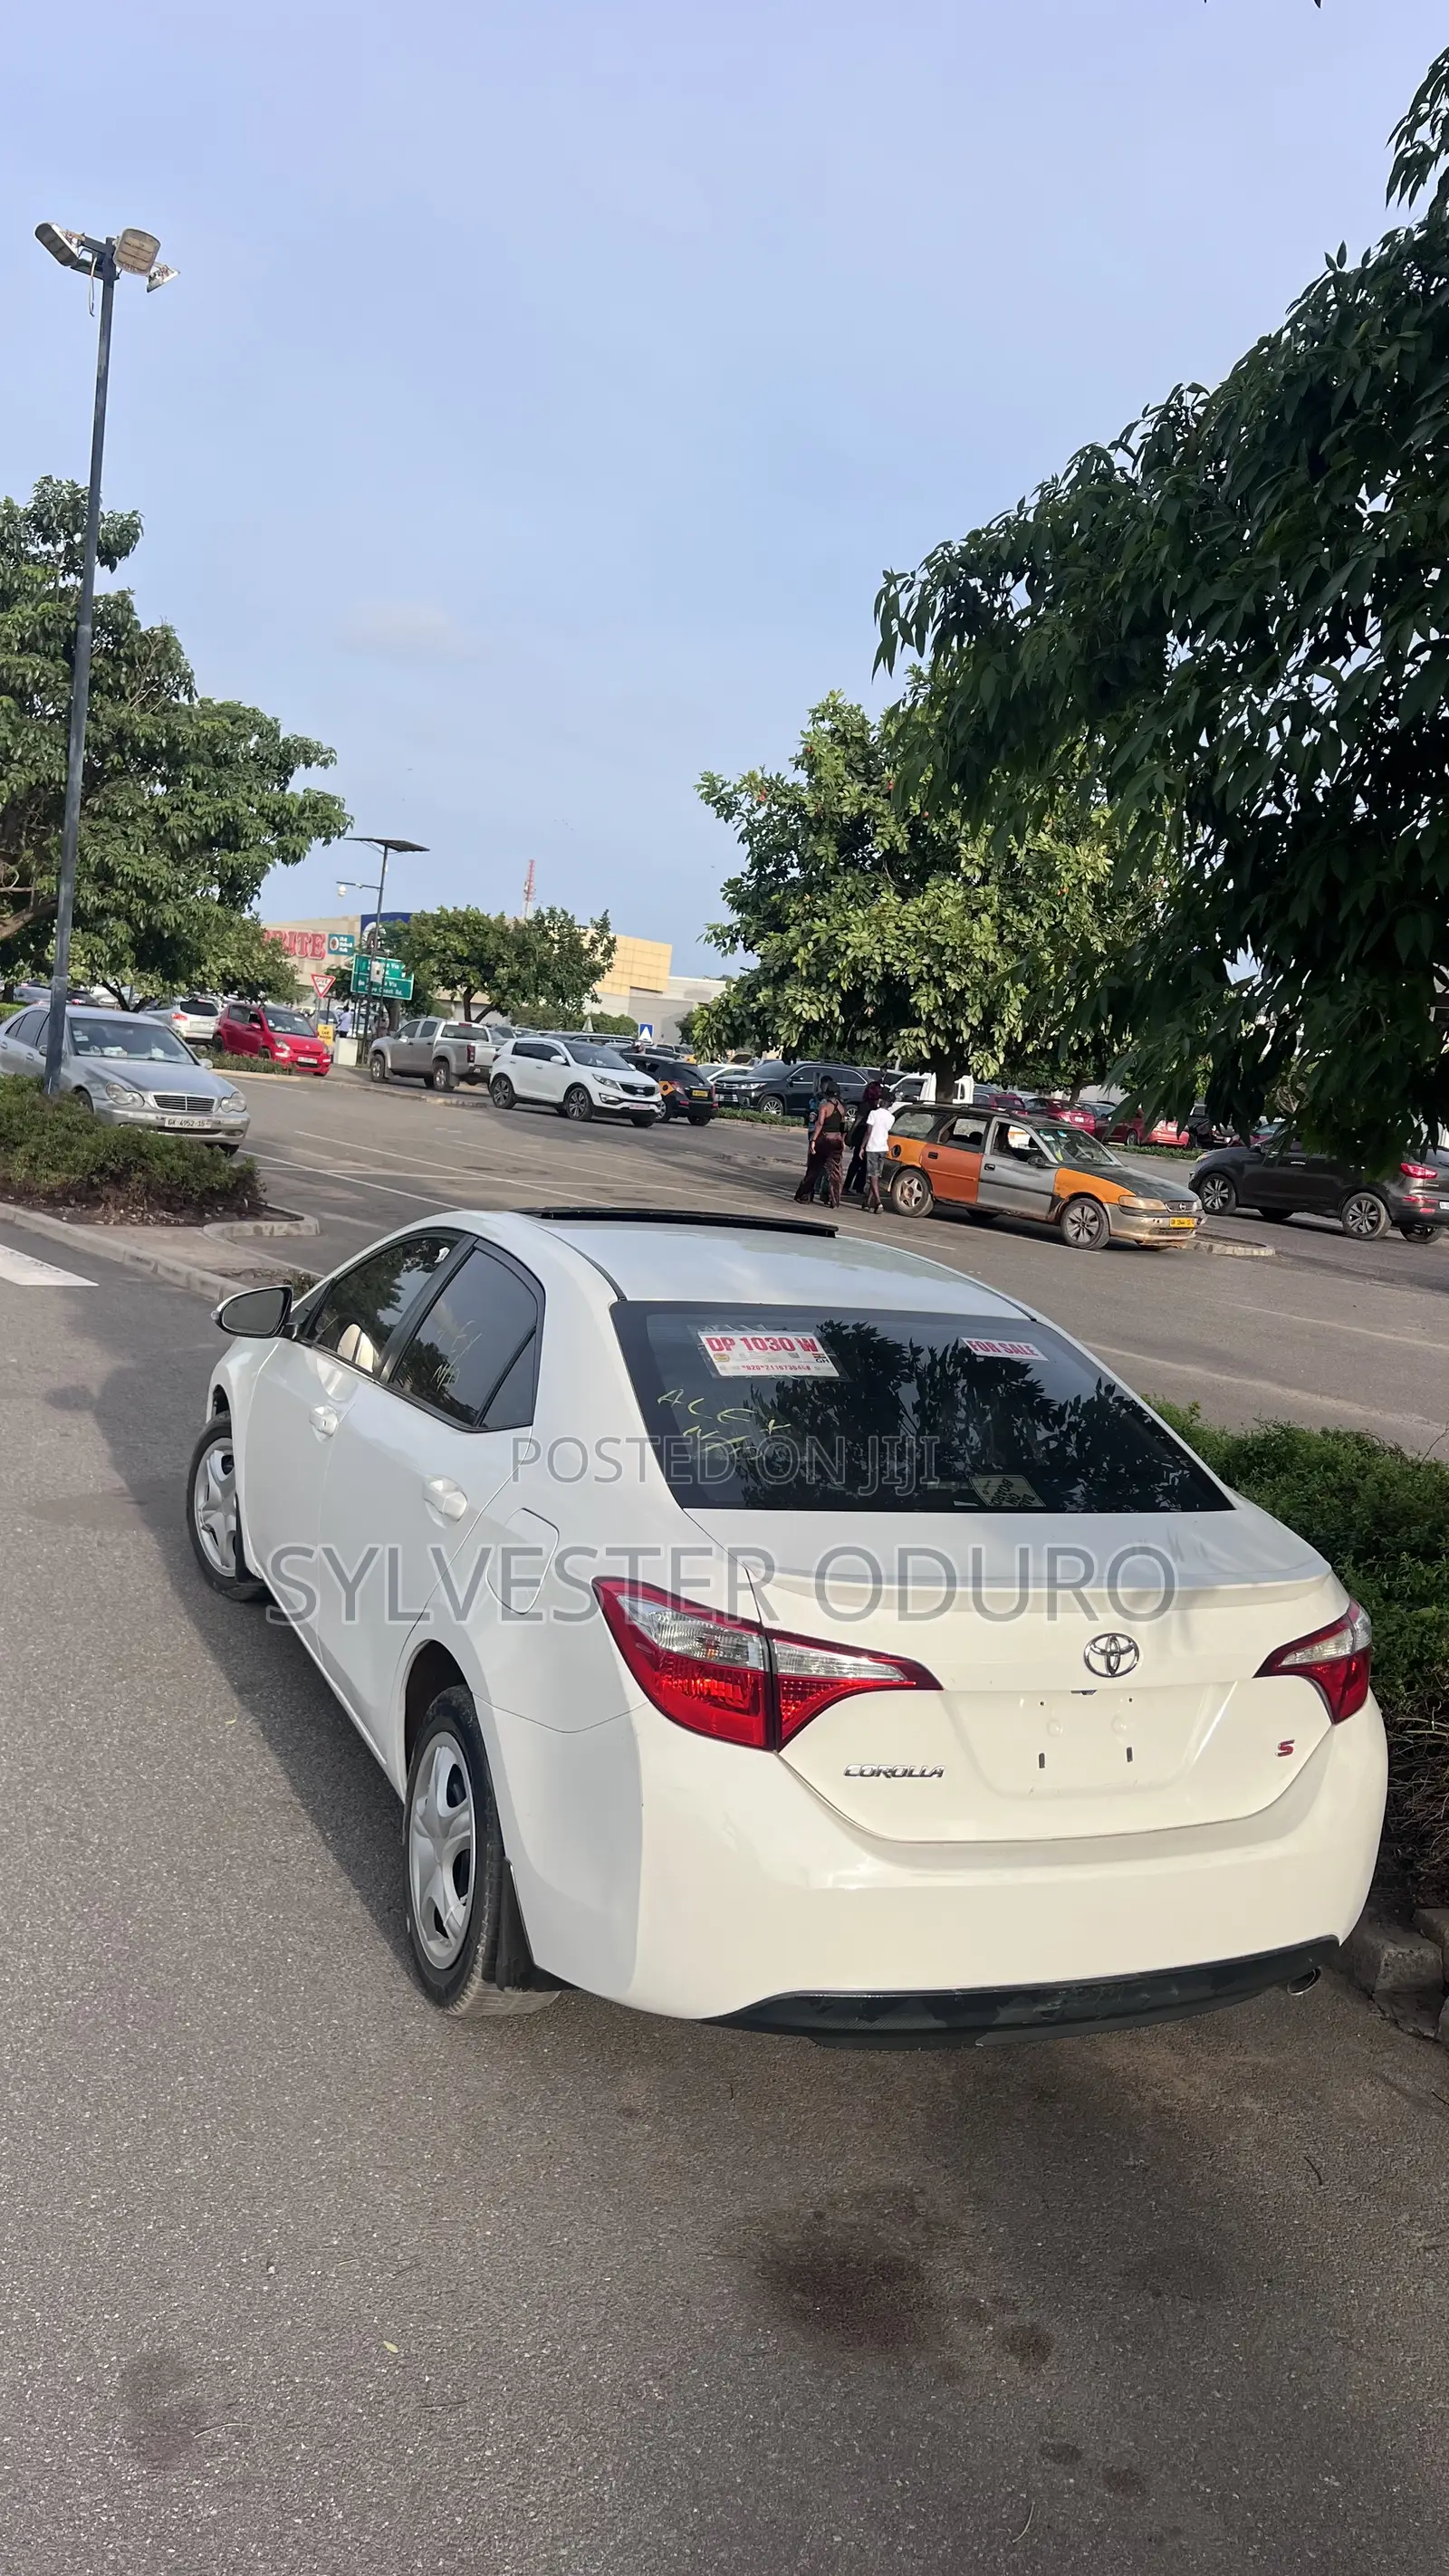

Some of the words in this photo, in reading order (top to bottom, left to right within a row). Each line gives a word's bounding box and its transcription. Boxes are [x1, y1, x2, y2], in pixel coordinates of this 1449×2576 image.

[705, 1337, 736, 1352] DP
[739, 1336, 796, 1352] 1030
[793, 1337, 819, 1353] W
[966, 1340, 1003, 1354] FOR
[998, 1343, 1040, 1356] SALE
[1275, 1738, 1296, 1757] S
[843, 1764, 945, 1778] COROLLA
